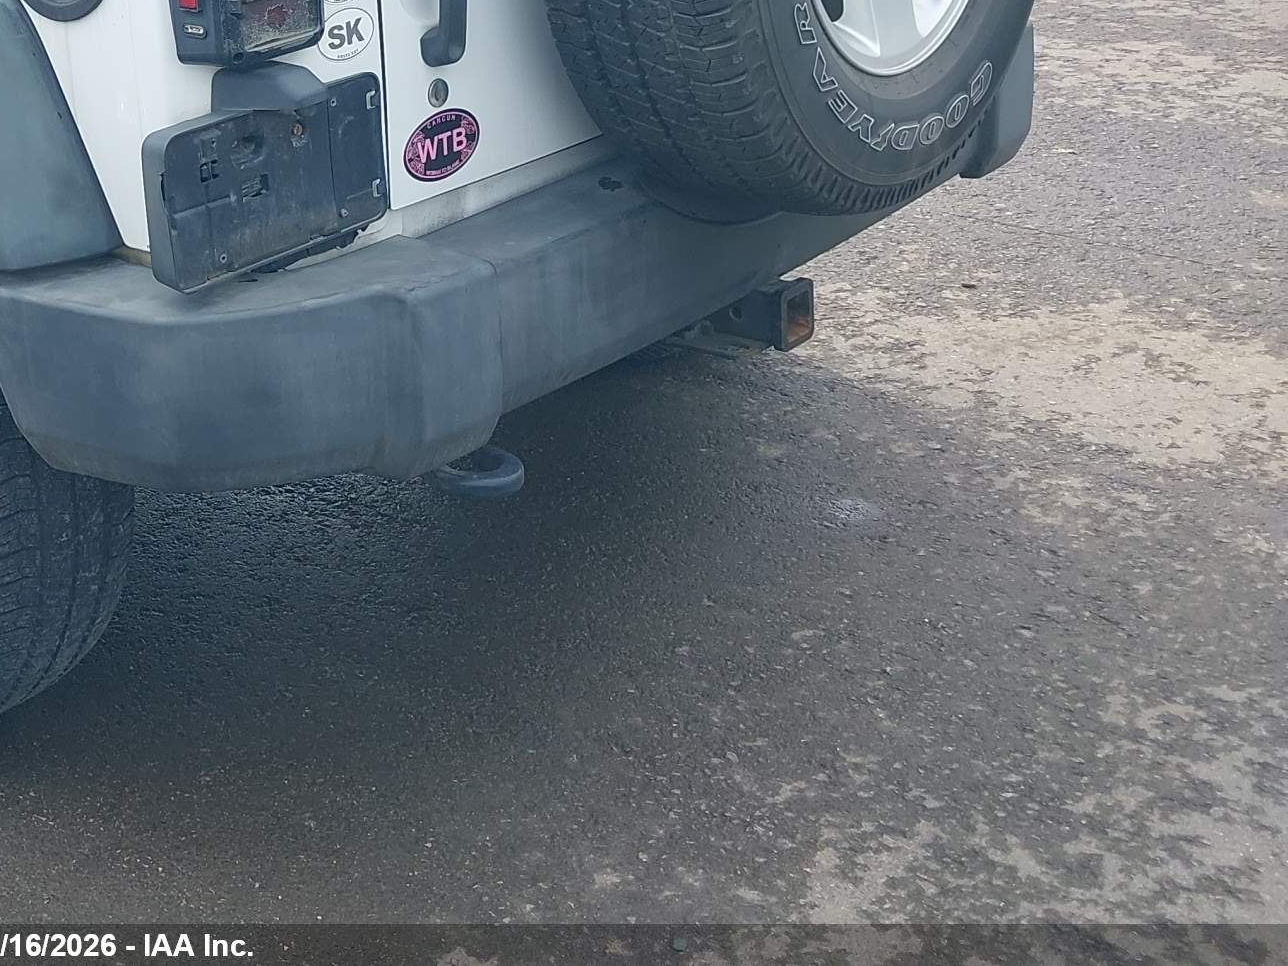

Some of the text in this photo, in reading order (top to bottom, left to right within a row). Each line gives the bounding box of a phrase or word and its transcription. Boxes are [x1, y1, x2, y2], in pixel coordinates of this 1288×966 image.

[328, 17, 365, 49] SK
[793, 1, 993, 152] GOODYEAR
[426, 114, 456, 129] CANCUN
[417, 127, 467, 164] WTB
